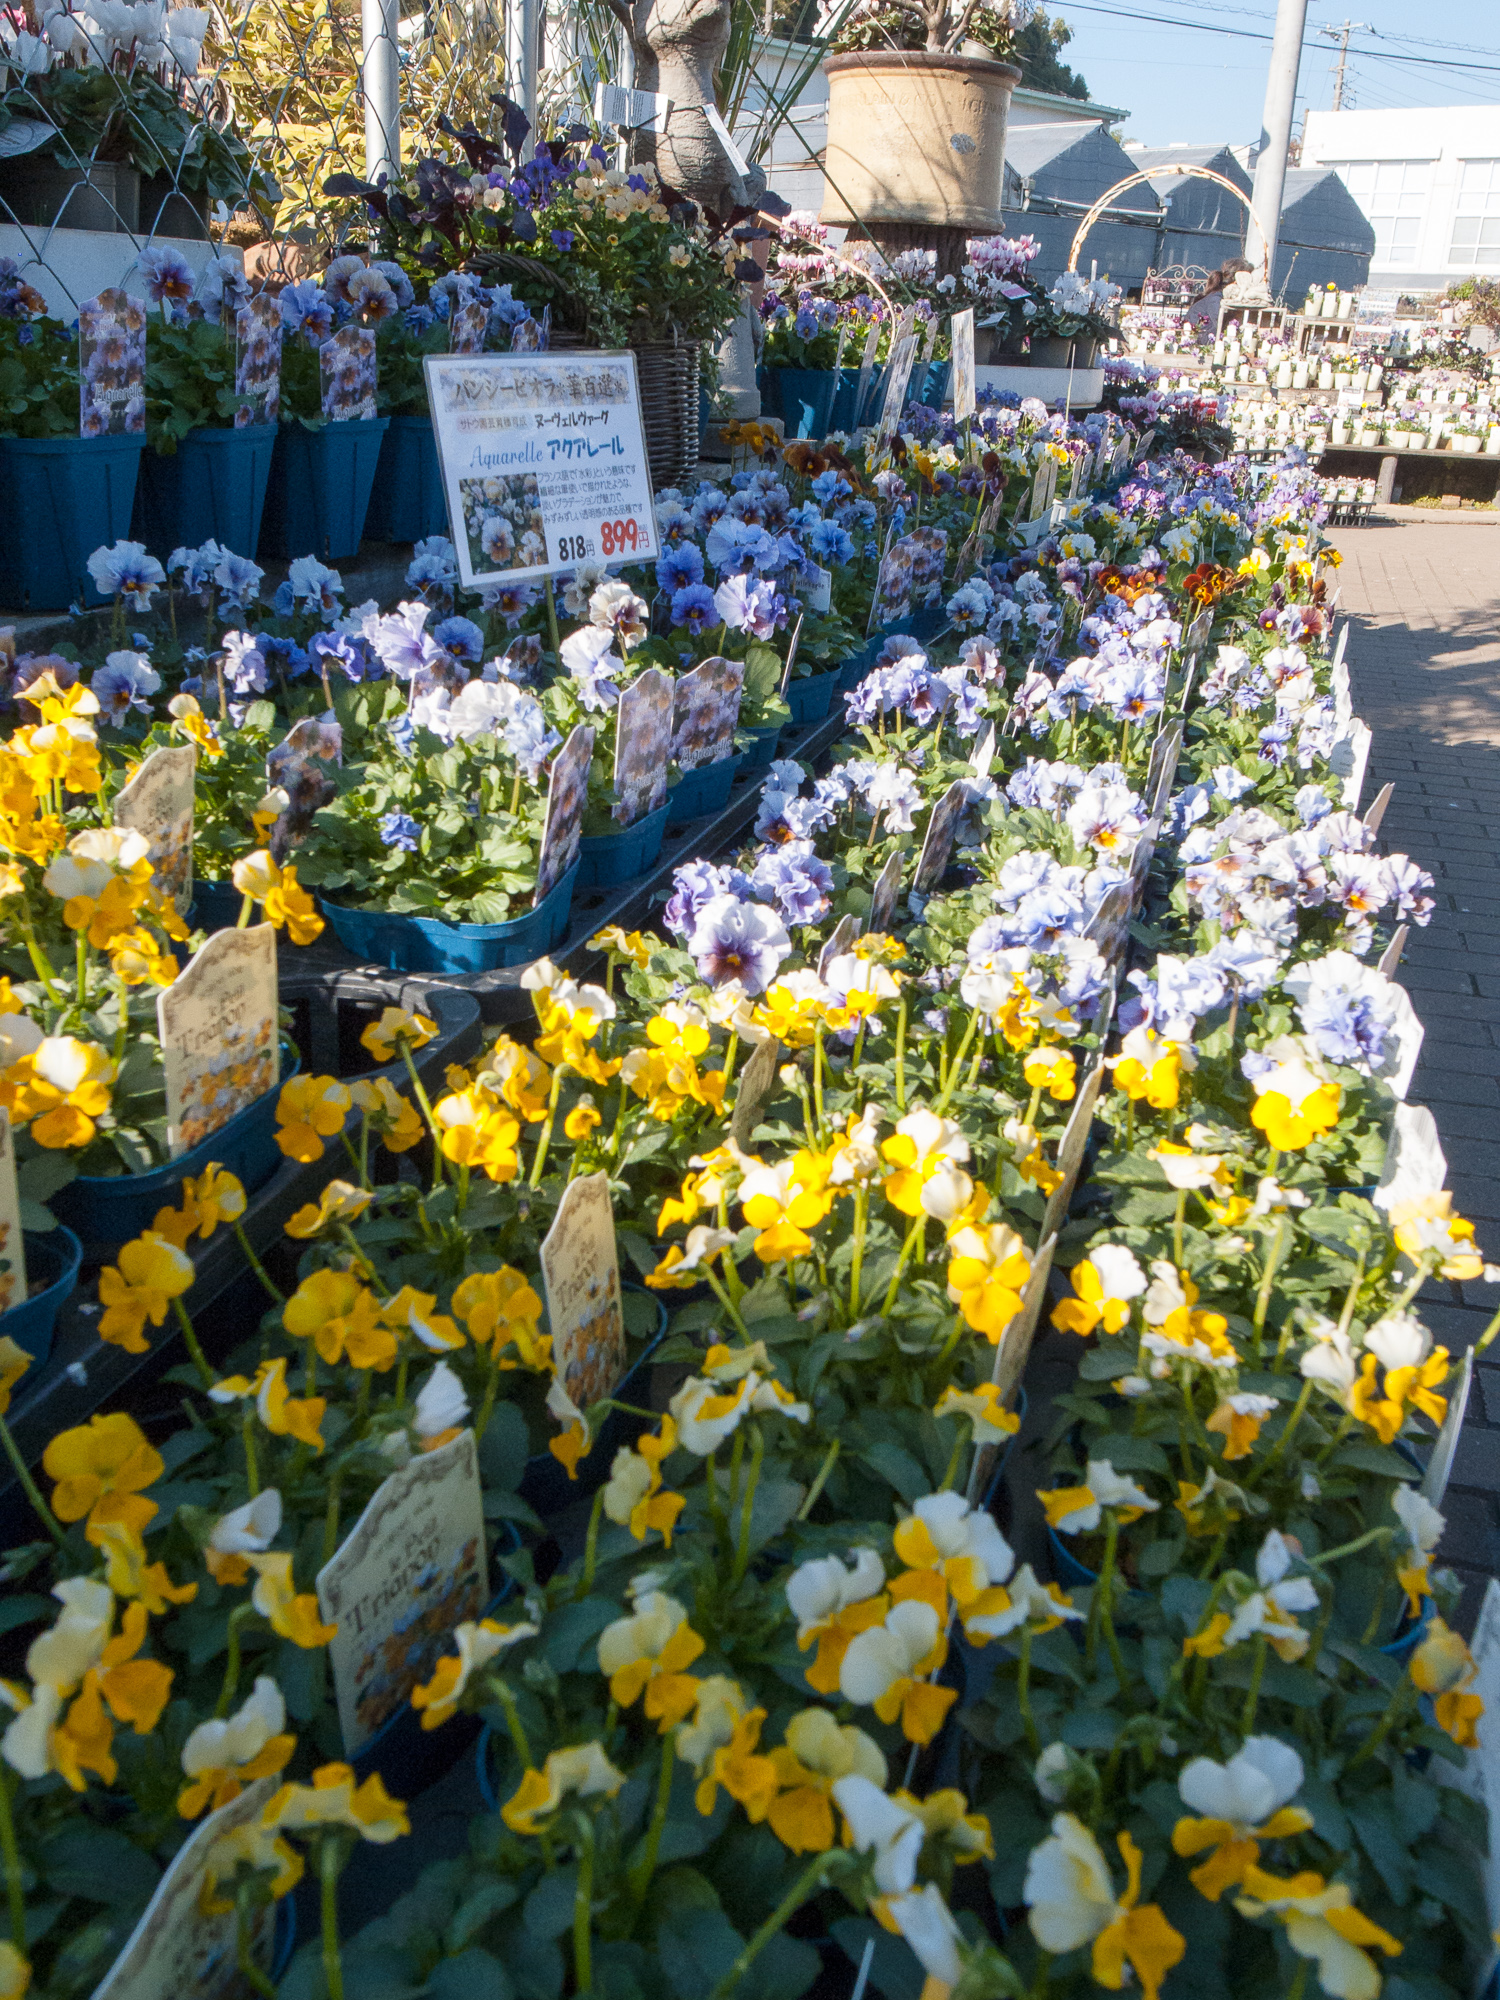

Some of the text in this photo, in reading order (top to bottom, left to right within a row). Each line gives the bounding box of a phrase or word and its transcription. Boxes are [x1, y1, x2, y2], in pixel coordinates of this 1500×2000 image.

[94, 381, 144, 402] Aquarelle
[534, 409, 609, 429] ヌーヴェルヴァーグ
[469, 435, 625, 469] Aquarelle アクアレール
